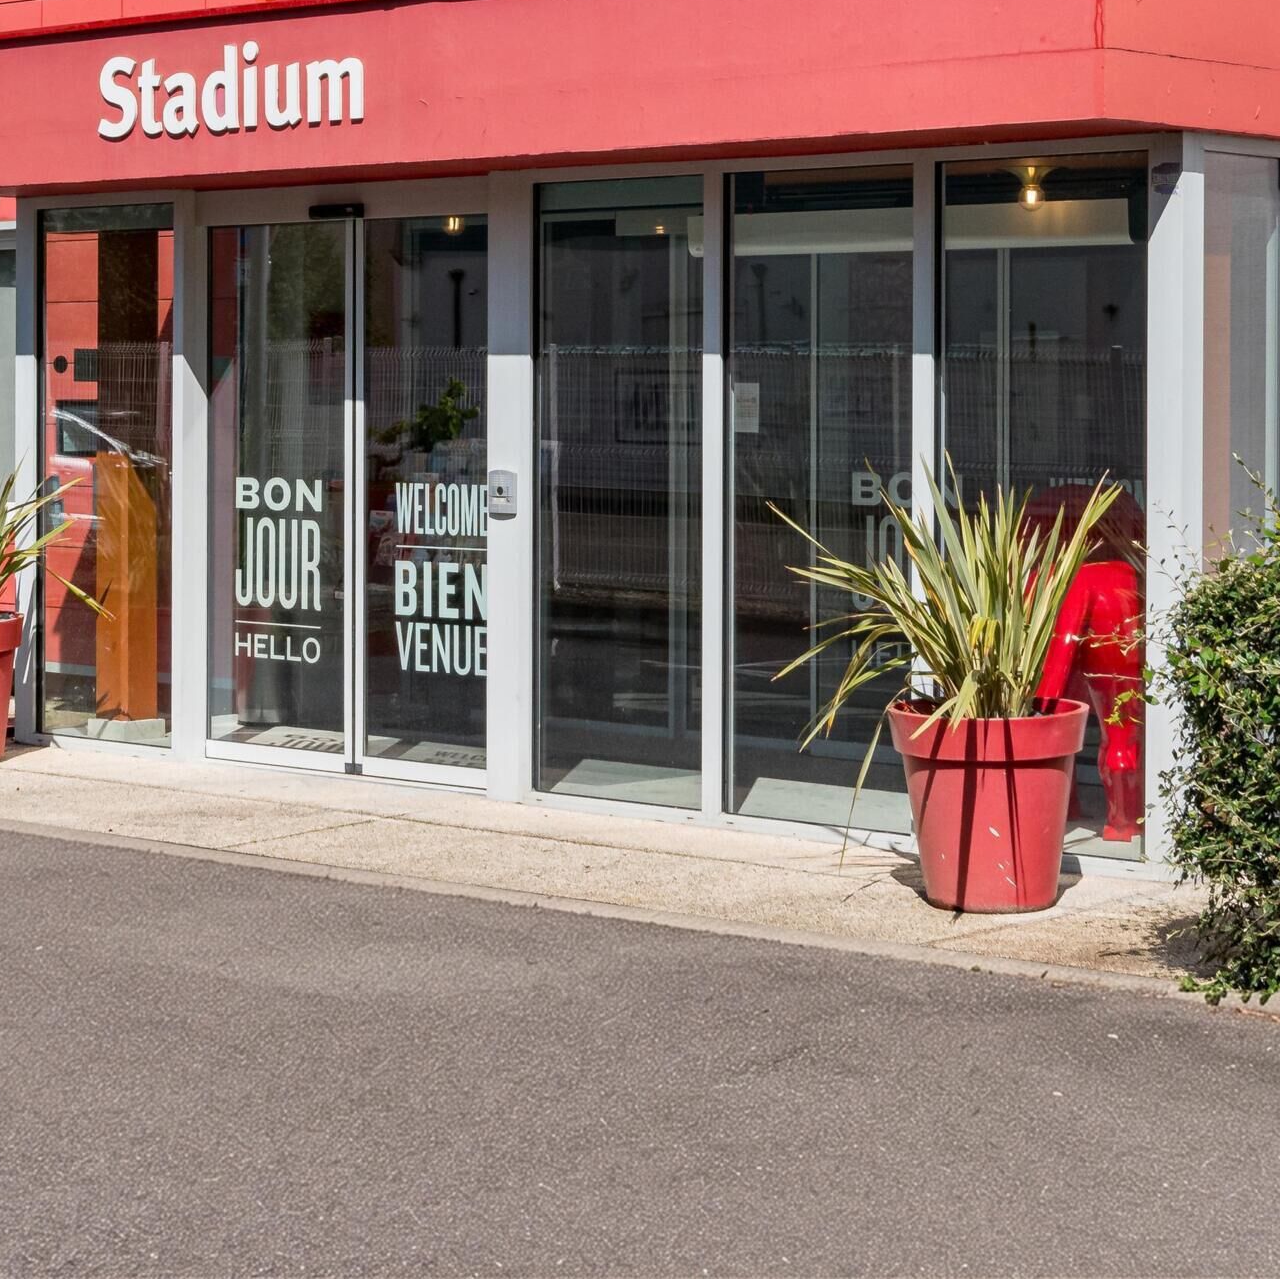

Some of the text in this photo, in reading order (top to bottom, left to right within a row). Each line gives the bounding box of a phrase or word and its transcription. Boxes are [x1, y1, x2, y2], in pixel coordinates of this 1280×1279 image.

[97, 40, 365, 142] Stadium
[235, 476, 322, 512] BON
[395, 482, 488, 537] WELCOME
[235, 517, 322, 612] JOUR
[394, 560, 488, 620] BIEN
[234, 632, 321, 664] HELLO
[395, 621, 488, 677] VENUE
